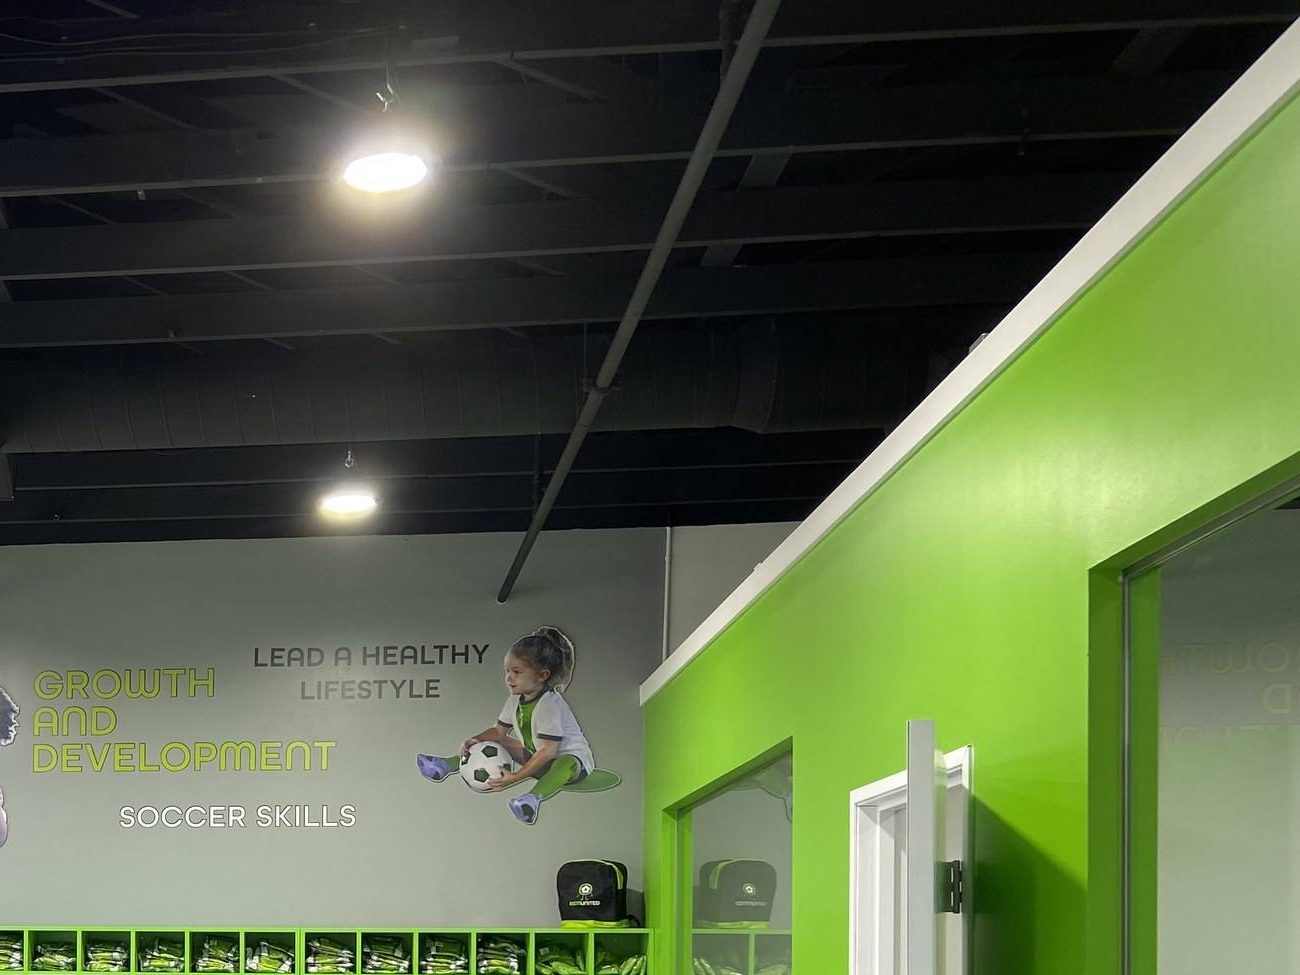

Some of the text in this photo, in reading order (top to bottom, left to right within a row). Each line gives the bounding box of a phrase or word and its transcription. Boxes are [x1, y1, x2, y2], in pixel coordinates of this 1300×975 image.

[252, 643, 490, 668] LEAD A HEALTHY
[33, 667, 216, 701] GROWTH
[299, 678, 441, 700] LIFESTYLE
[32, 705, 118, 738] AND
[31, 739, 338, 775] DEVELOPMENT
[117, 804, 357, 829] SOCCER SKILLS
